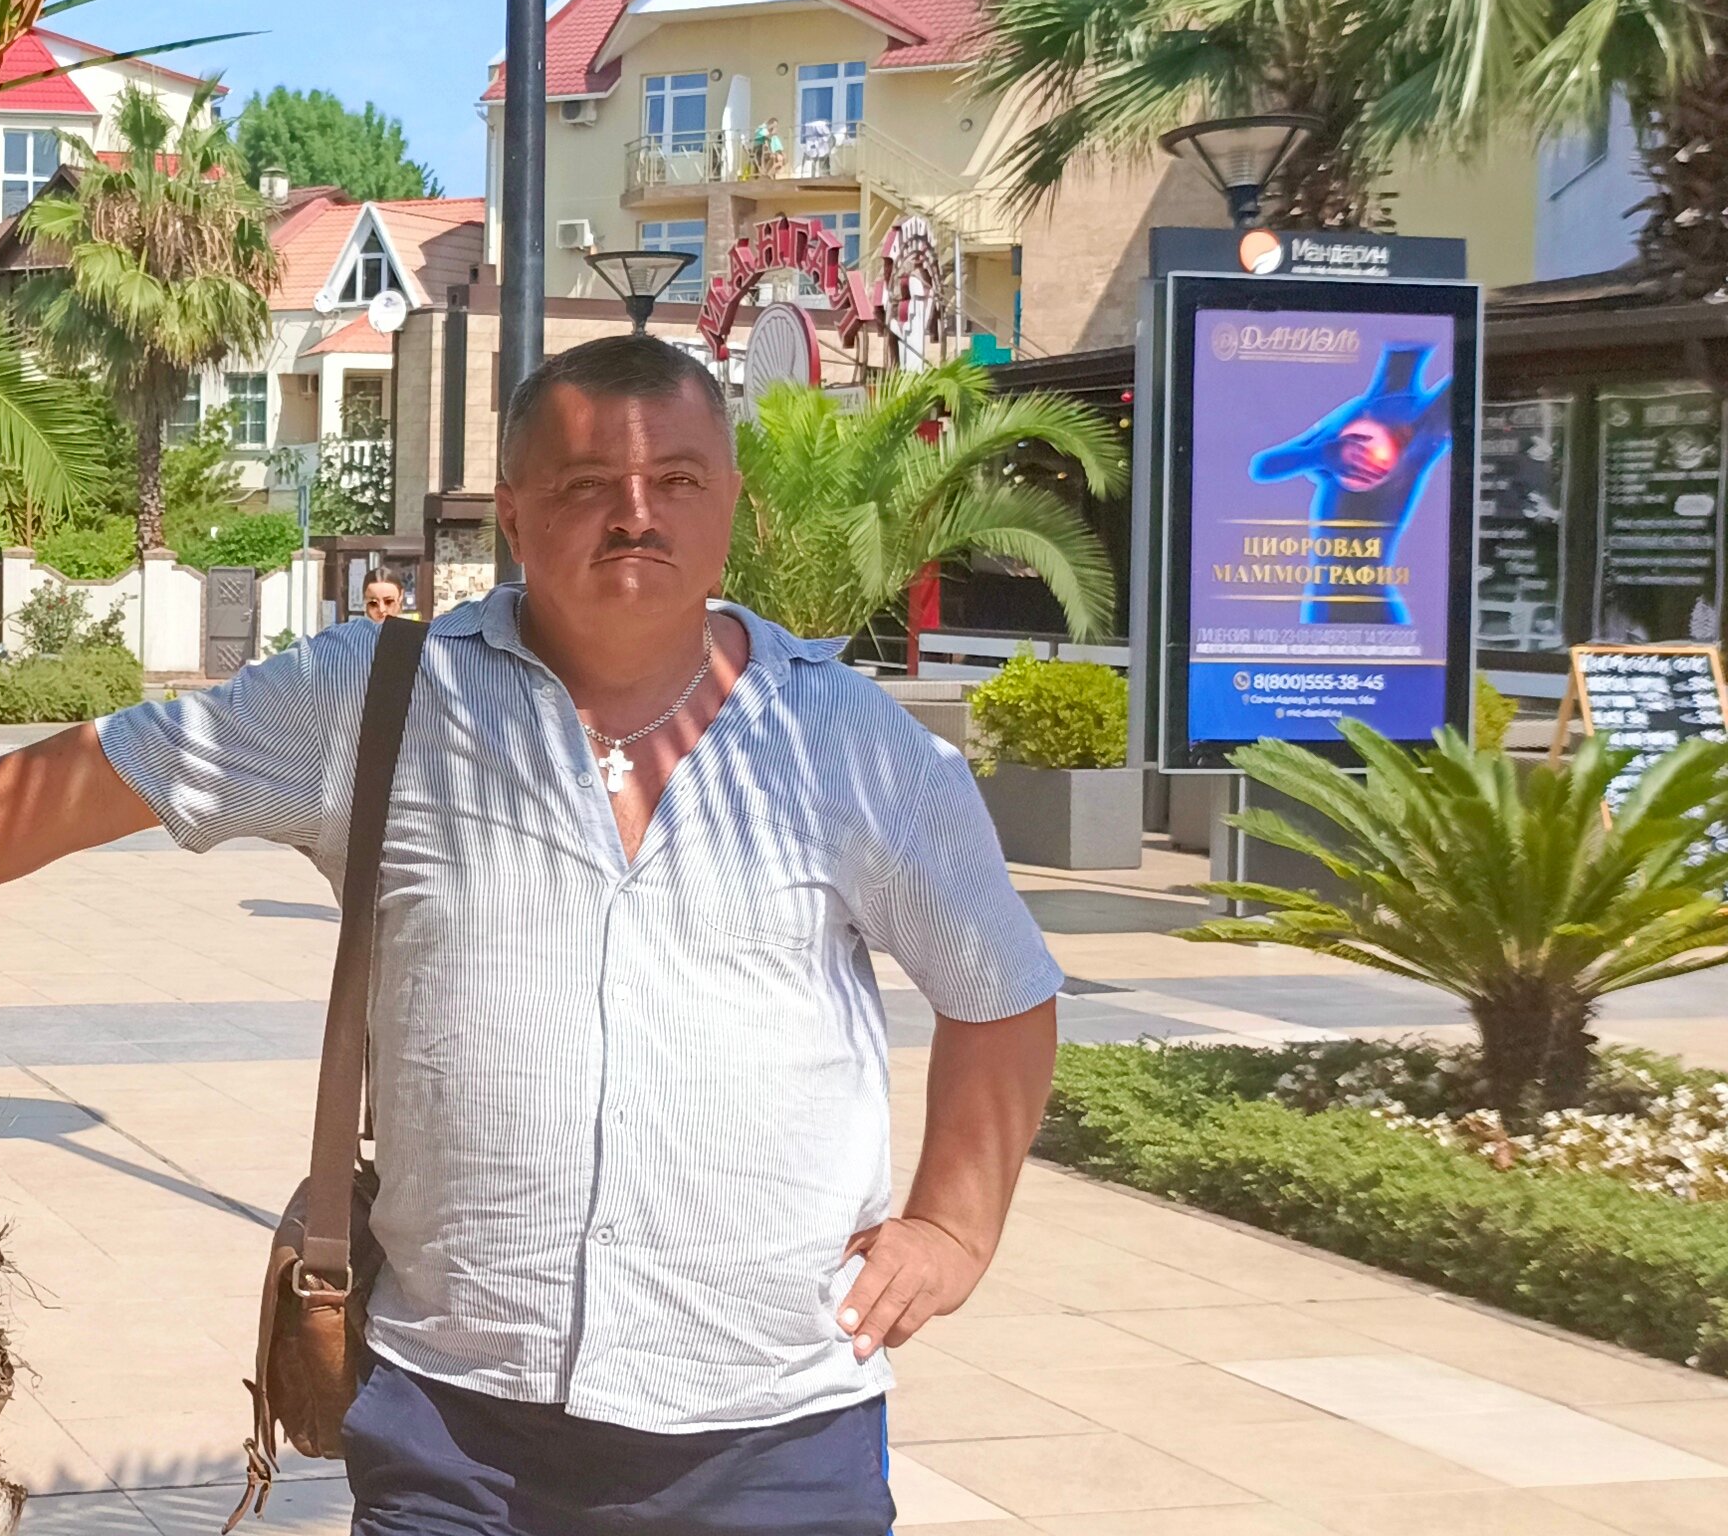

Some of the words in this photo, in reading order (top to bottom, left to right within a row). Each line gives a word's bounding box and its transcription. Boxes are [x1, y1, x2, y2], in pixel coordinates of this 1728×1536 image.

[1292, 237, 1390, 267] Мандарин
[696, 216, 874, 361] МАНГАЛ
[1243, 536, 1381, 558] ЦИФРОВАЯ
[1211, 564, 1410, 585] МАММОГРАФИЯ
